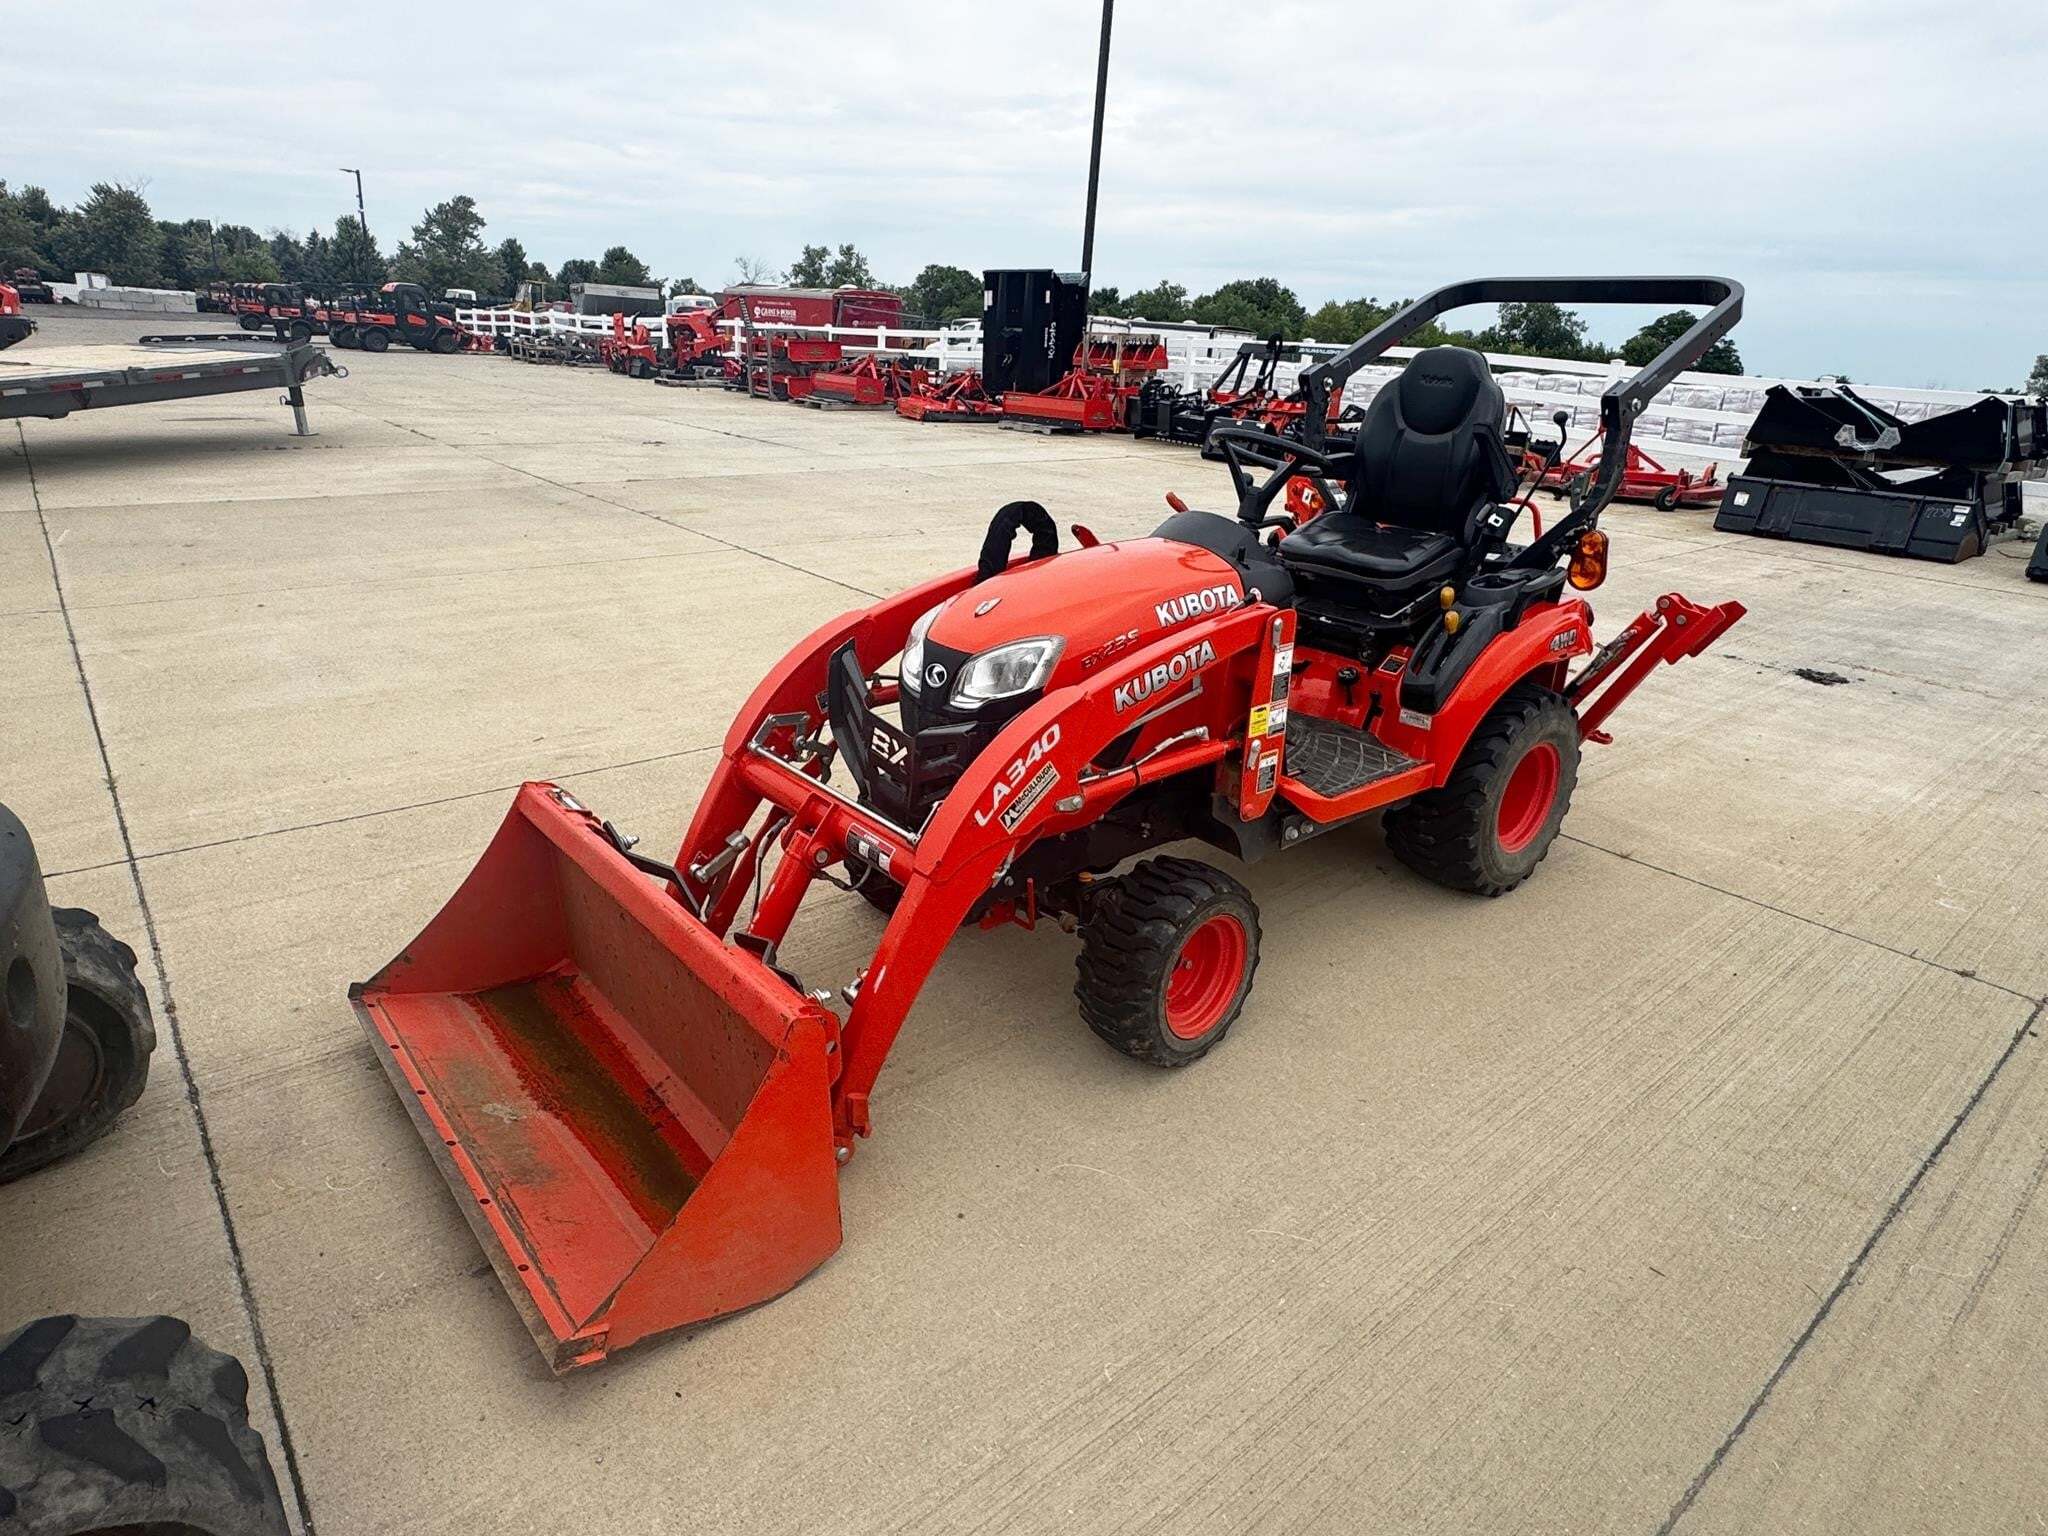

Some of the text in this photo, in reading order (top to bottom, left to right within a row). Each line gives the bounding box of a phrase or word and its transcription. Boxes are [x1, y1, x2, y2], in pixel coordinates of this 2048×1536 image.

[1154, 583, 1240, 627] KUBOTA
[1550, 628, 1577, 651] 4WD
[1114, 639, 1217, 713] KUBOTA
[871, 727, 908, 769] BX
[974, 723, 1060, 827] LA340
